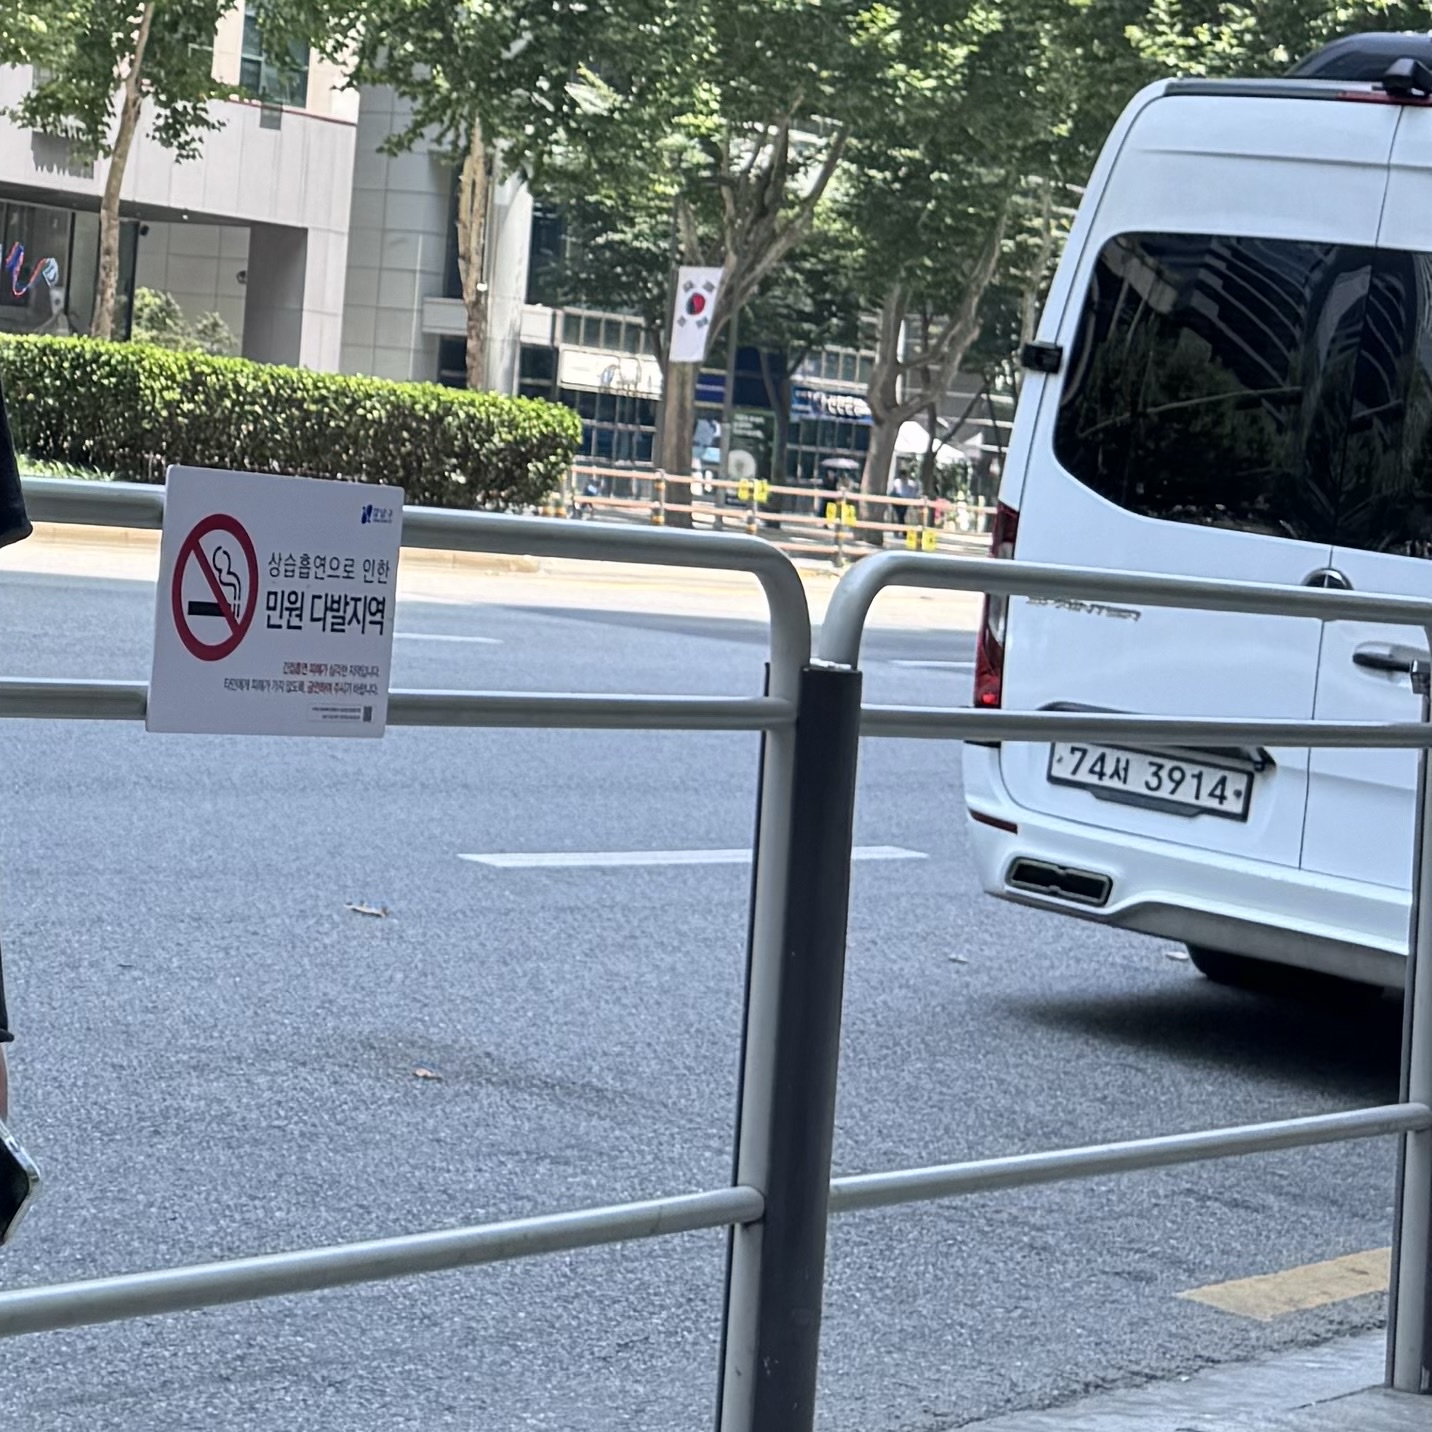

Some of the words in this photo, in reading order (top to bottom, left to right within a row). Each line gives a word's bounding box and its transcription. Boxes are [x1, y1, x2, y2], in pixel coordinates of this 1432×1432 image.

[268, 552, 355, 580] 상습흡연으로
[362, 559, 390, 584] 인한
[266, 589, 305, 631] 민원
[309, 592, 386, 636] 다발지역
[1070, 746, 1130, 785] 74서
[1144, 760, 1228, 806] 3914
